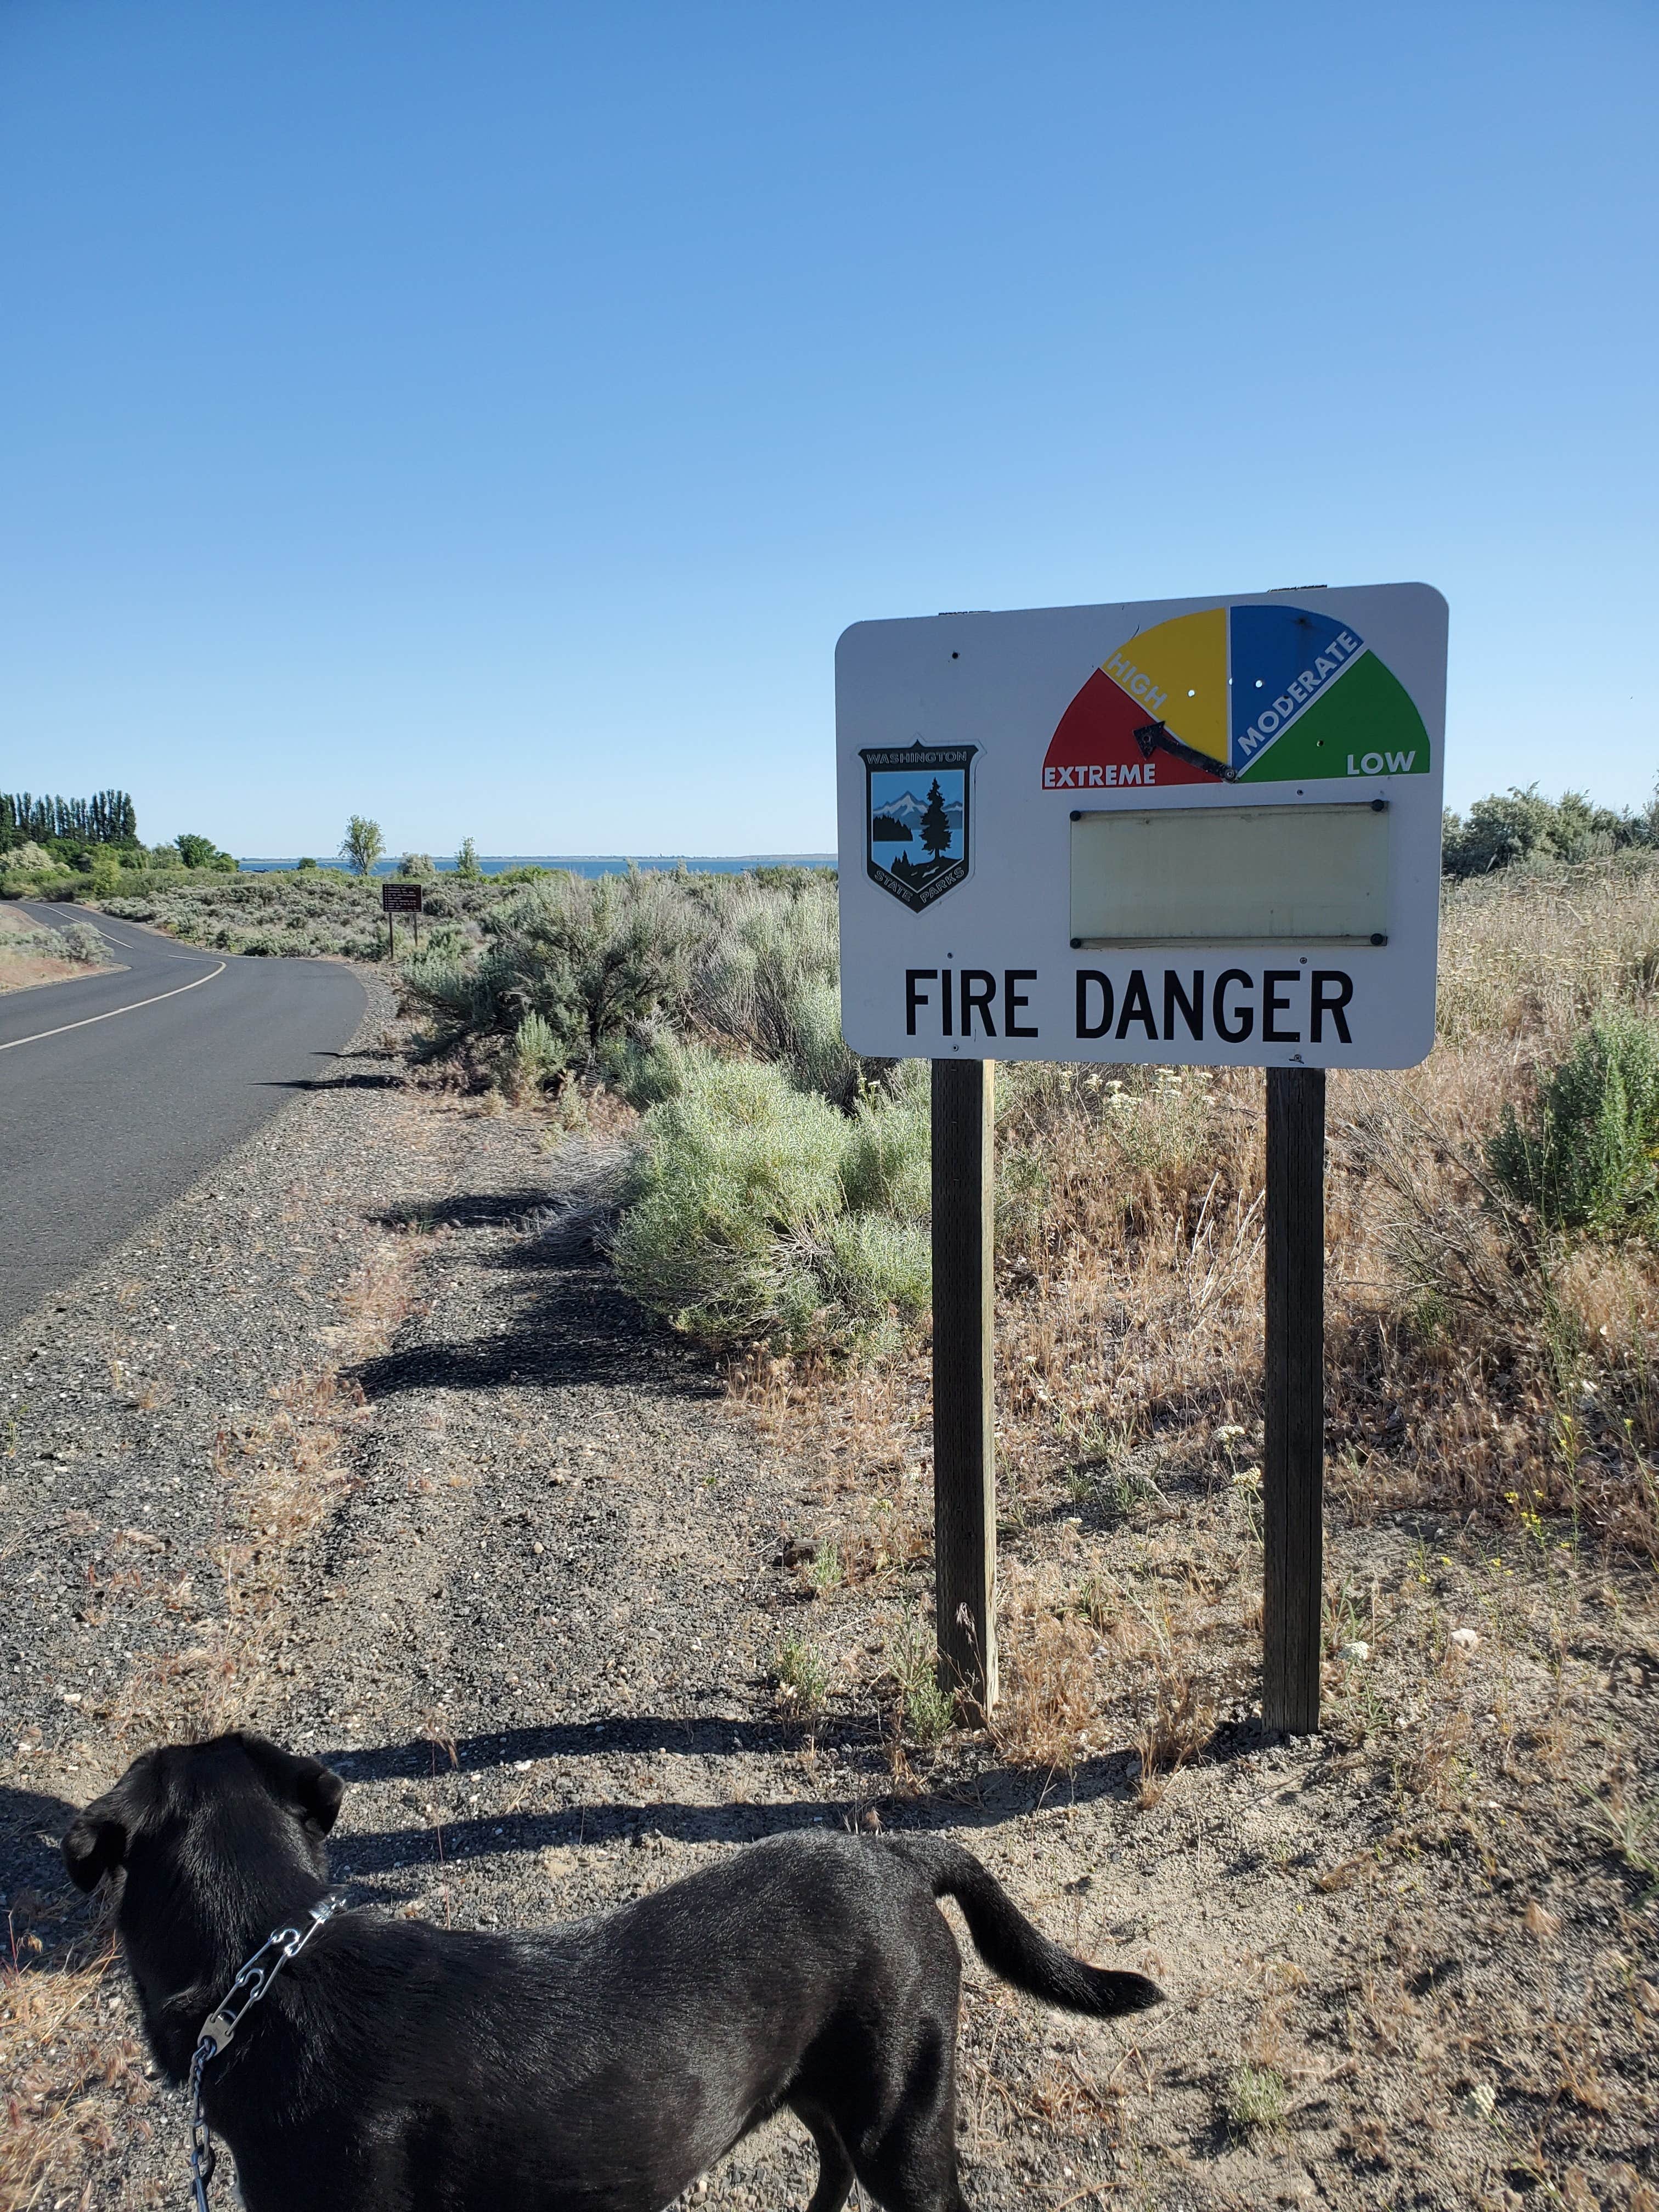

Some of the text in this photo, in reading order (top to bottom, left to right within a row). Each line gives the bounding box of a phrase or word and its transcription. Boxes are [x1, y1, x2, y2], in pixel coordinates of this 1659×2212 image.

[1107, 653, 1167, 710] HIGH
[1238, 631, 1358, 756] MODERATE
[867, 751, 967, 764] WASHINGTON
[1045, 764, 1155, 787] EXTREME
[1347, 751, 1415, 775] LOW
[874, 867, 964, 904] STATE PARKS
[905, 968, 1354, 1044] FIRE DANGER
